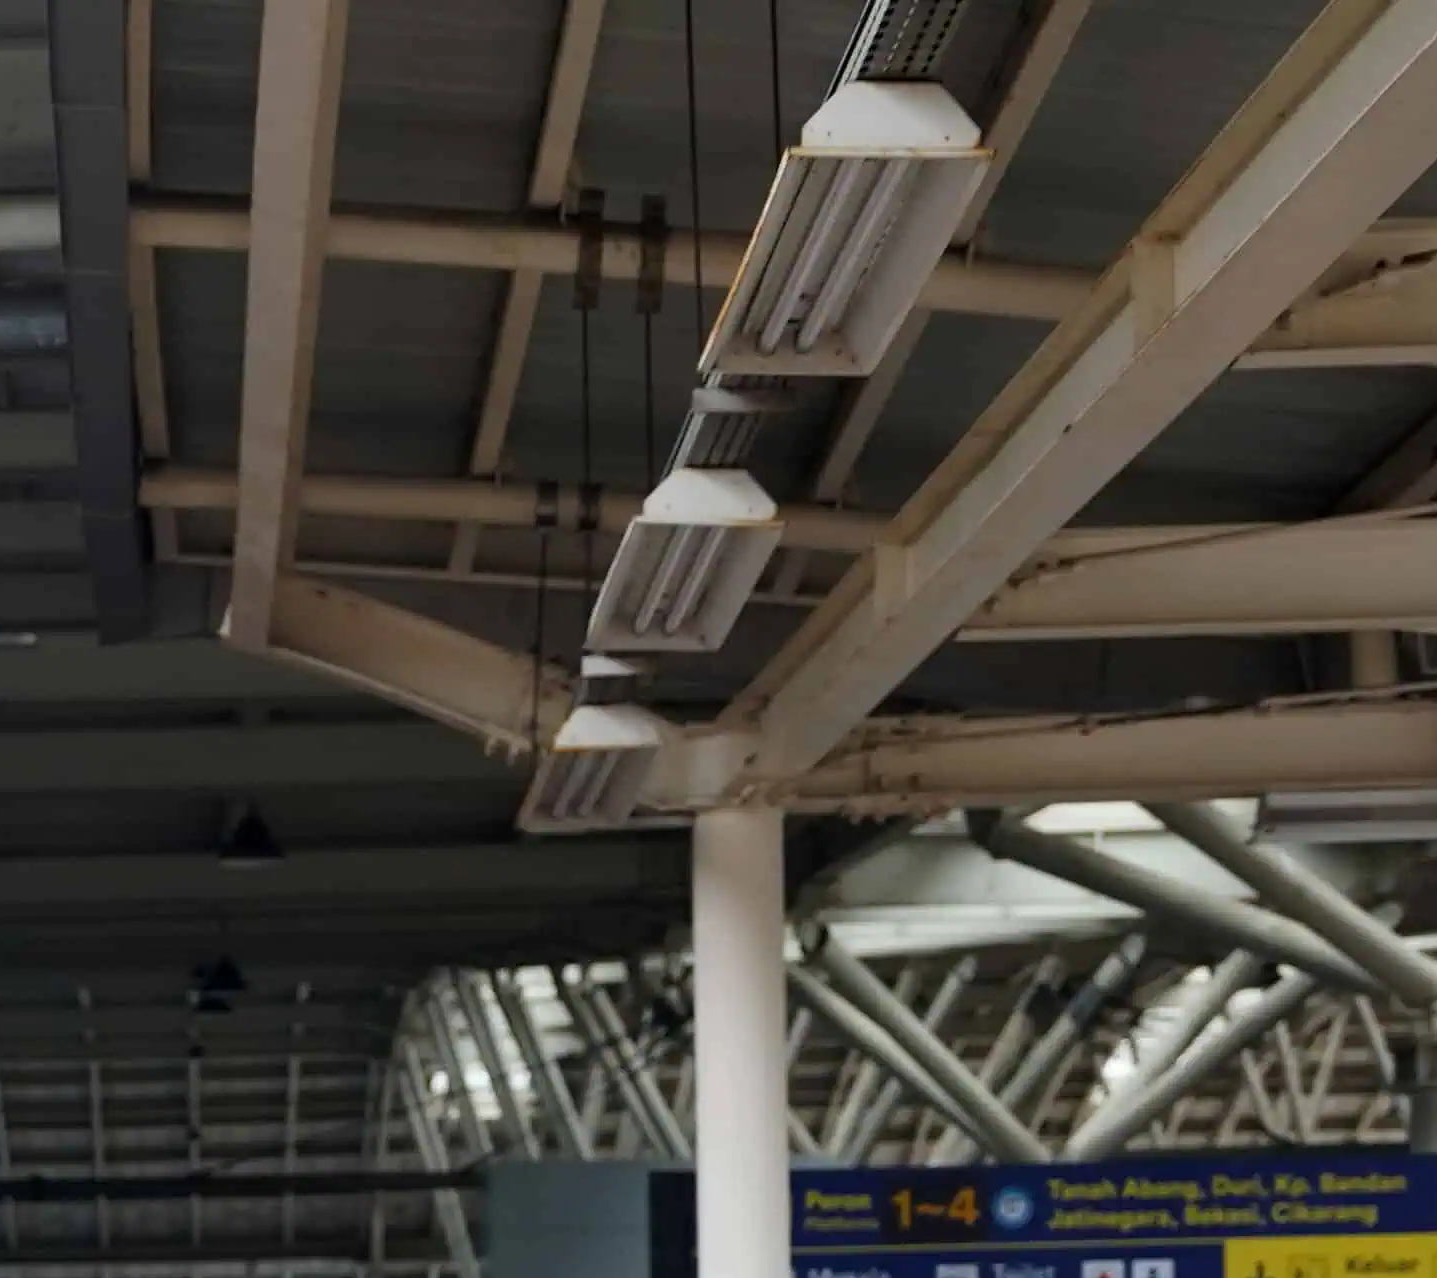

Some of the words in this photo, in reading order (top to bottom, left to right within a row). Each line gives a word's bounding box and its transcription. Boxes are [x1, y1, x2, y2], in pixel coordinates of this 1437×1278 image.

[1047, 1178, 1116, 1199] Tanah
[1273, 1202, 1379, 1227] Cikarang
[1344, 1254, 1422, 1274] Keluar
